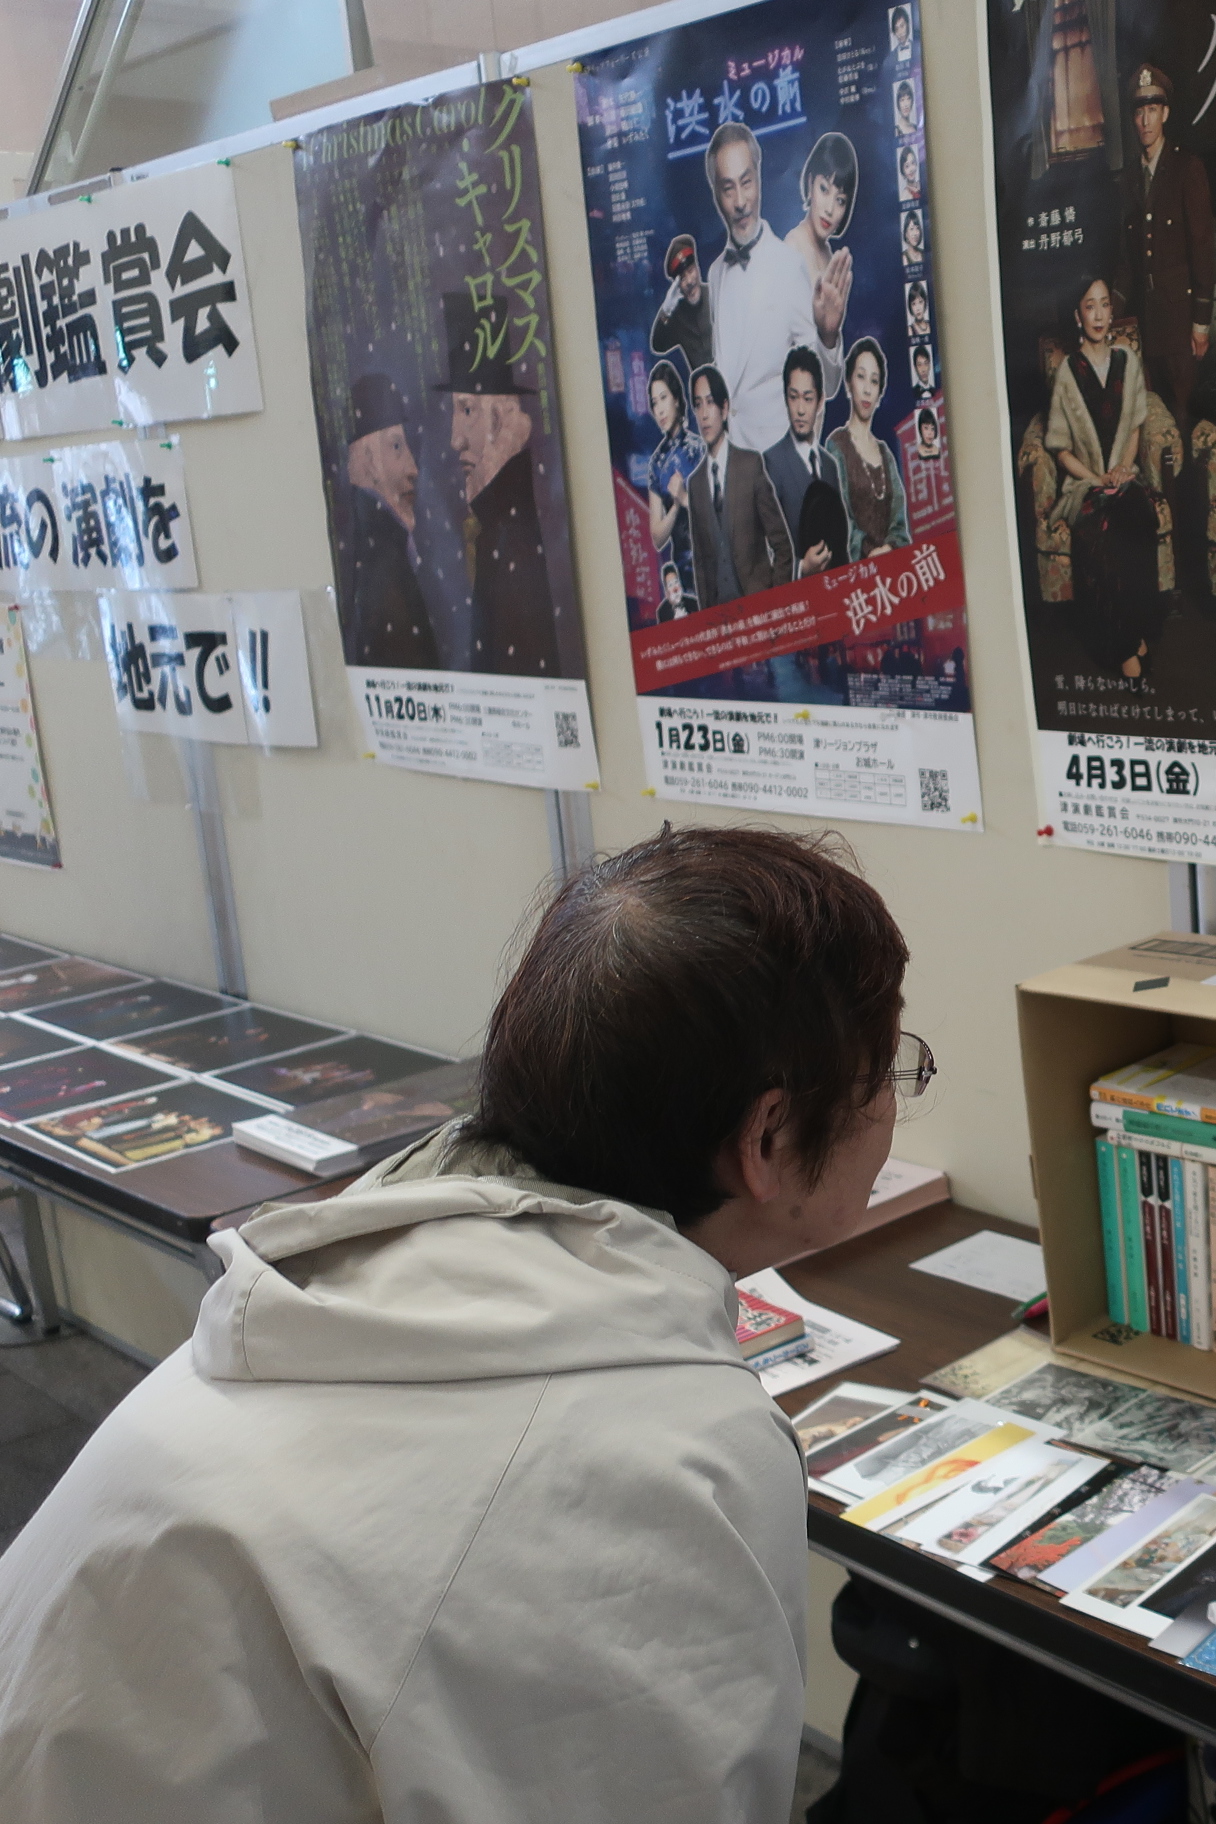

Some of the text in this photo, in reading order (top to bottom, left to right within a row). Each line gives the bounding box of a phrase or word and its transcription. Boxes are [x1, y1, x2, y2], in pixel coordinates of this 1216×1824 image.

[727, 46, 805, 80] ミュージカル
[666, 70, 803, 144] 洪水の前
[484, 84, 547, 364] クリスマス
[823, 561, 878, 591] ミュージカル
[843, 543, 947, 636] 洪水の前
[1054, 674, 1157, 695] 雪、降らないかしら。
[655, 720, 750, 754] 1月23日(金)
[1066, 753, 1199, 796] 4月3日(金)
[1059, 800, 1130, 821] 津演劇鑑賞会
[1062, 820, 1153, 841] 電話059-261-6046
